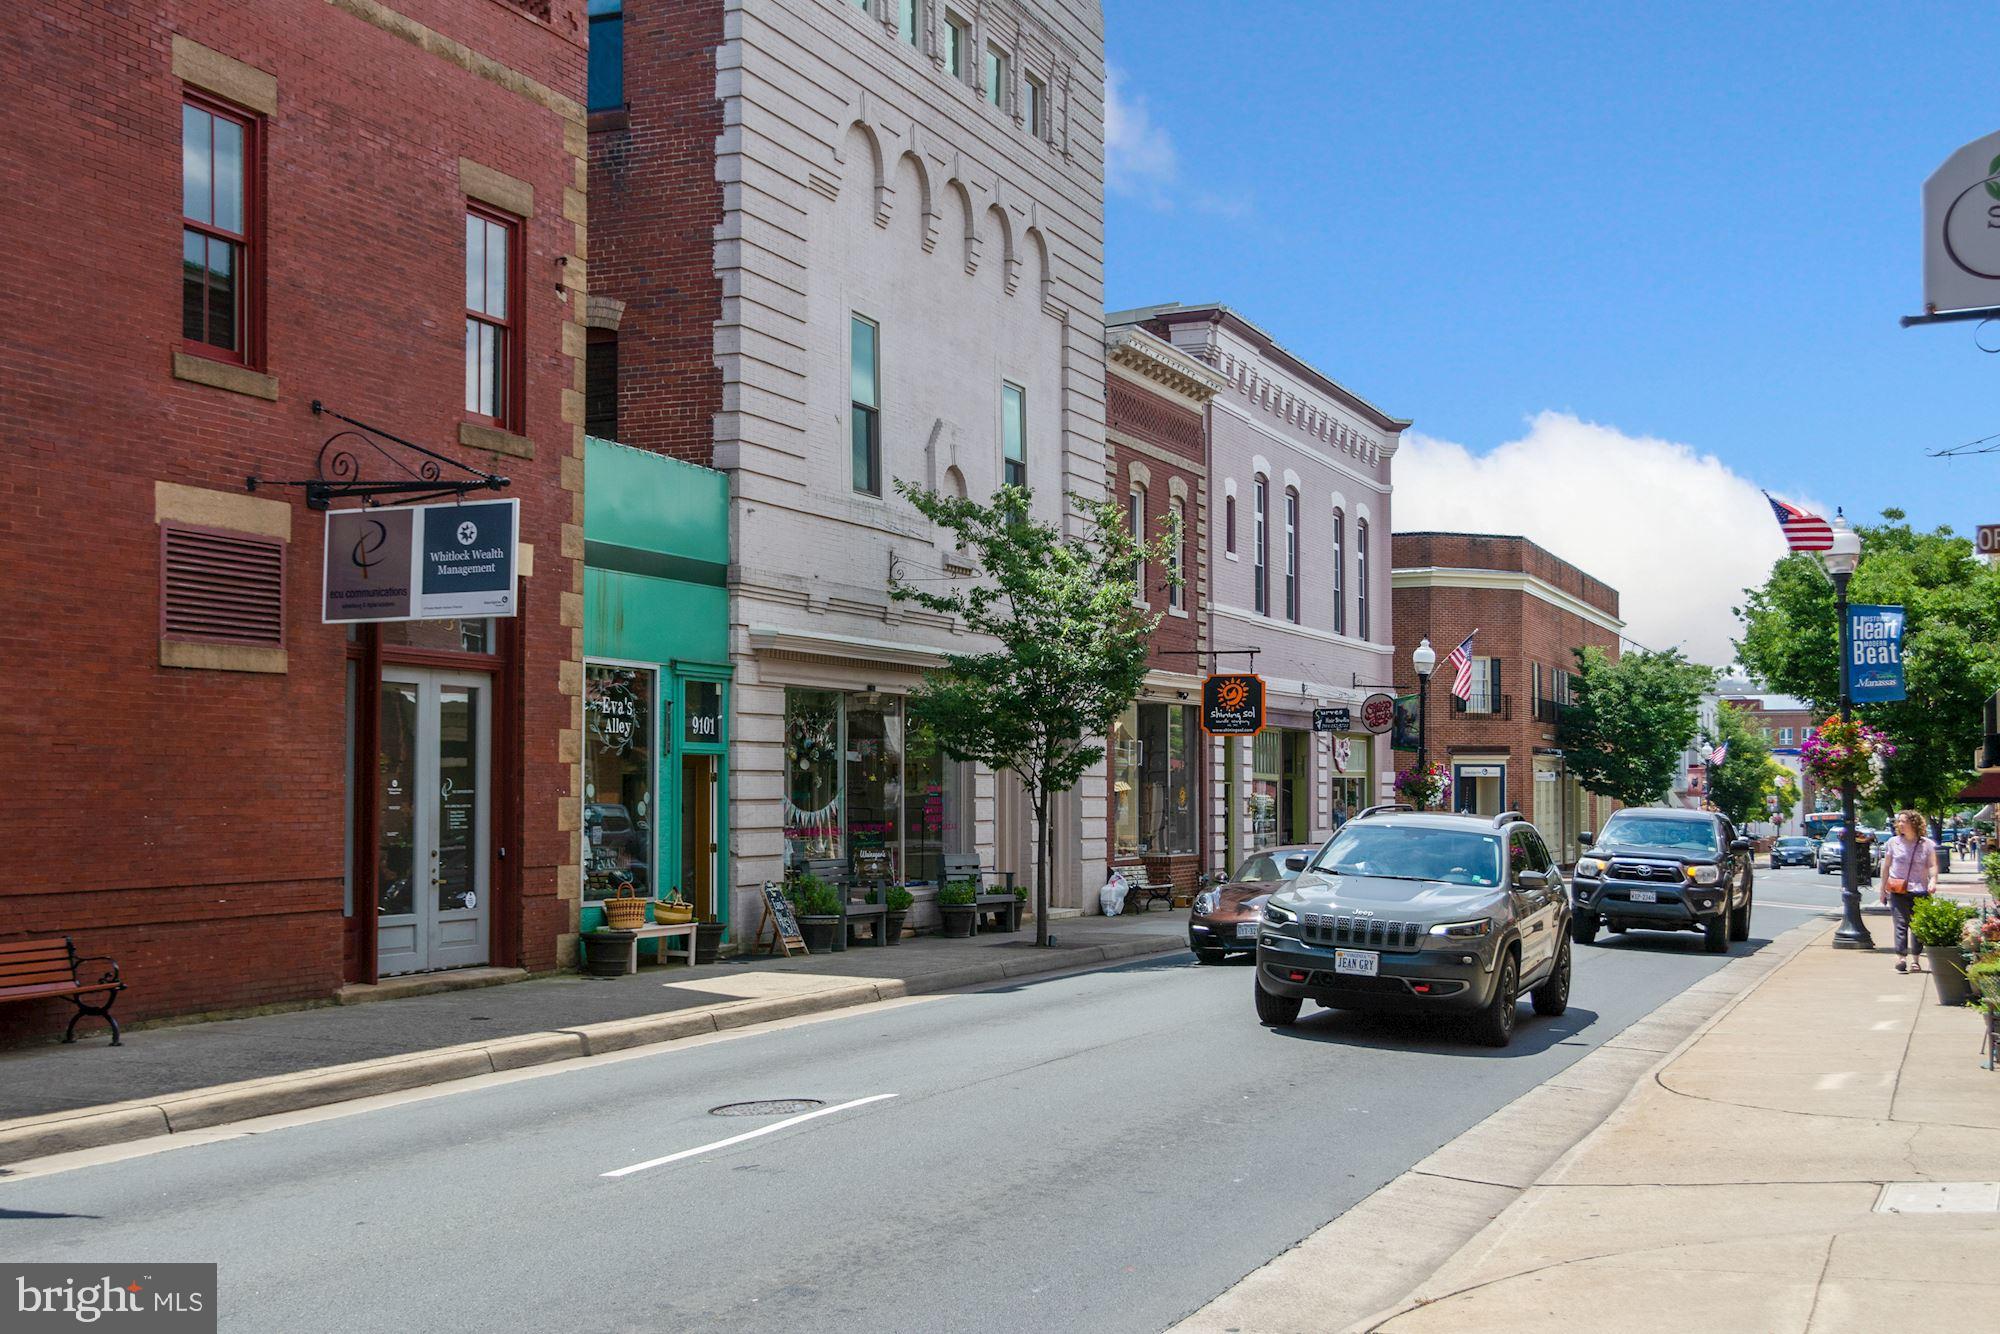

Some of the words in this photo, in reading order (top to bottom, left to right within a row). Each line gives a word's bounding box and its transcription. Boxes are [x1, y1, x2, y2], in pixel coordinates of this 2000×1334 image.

[430, 550, 470, 562] Whitlock
[472, 548, 504, 559] Wealth
[438, 563, 496, 576] Management
[345, 588, 408, 599] communications
[1853, 616, 1898, 640] Heart
[1854, 641, 1898, 665] Beat
[1855, 679, 1897, 688] Manassas
[602, 696, 633, 715] Eva's
[1210, 706, 1242, 721] shining
[1243, 706, 1256, 718] sol
[604, 718, 632, 737] Alley
[692, 716, 715, 735] 9101
[1352, 909, 1374, 917] Jeep
[1338, 957, 1357, 968] JEAN
[1359, 959, 1374, 970] GRY
